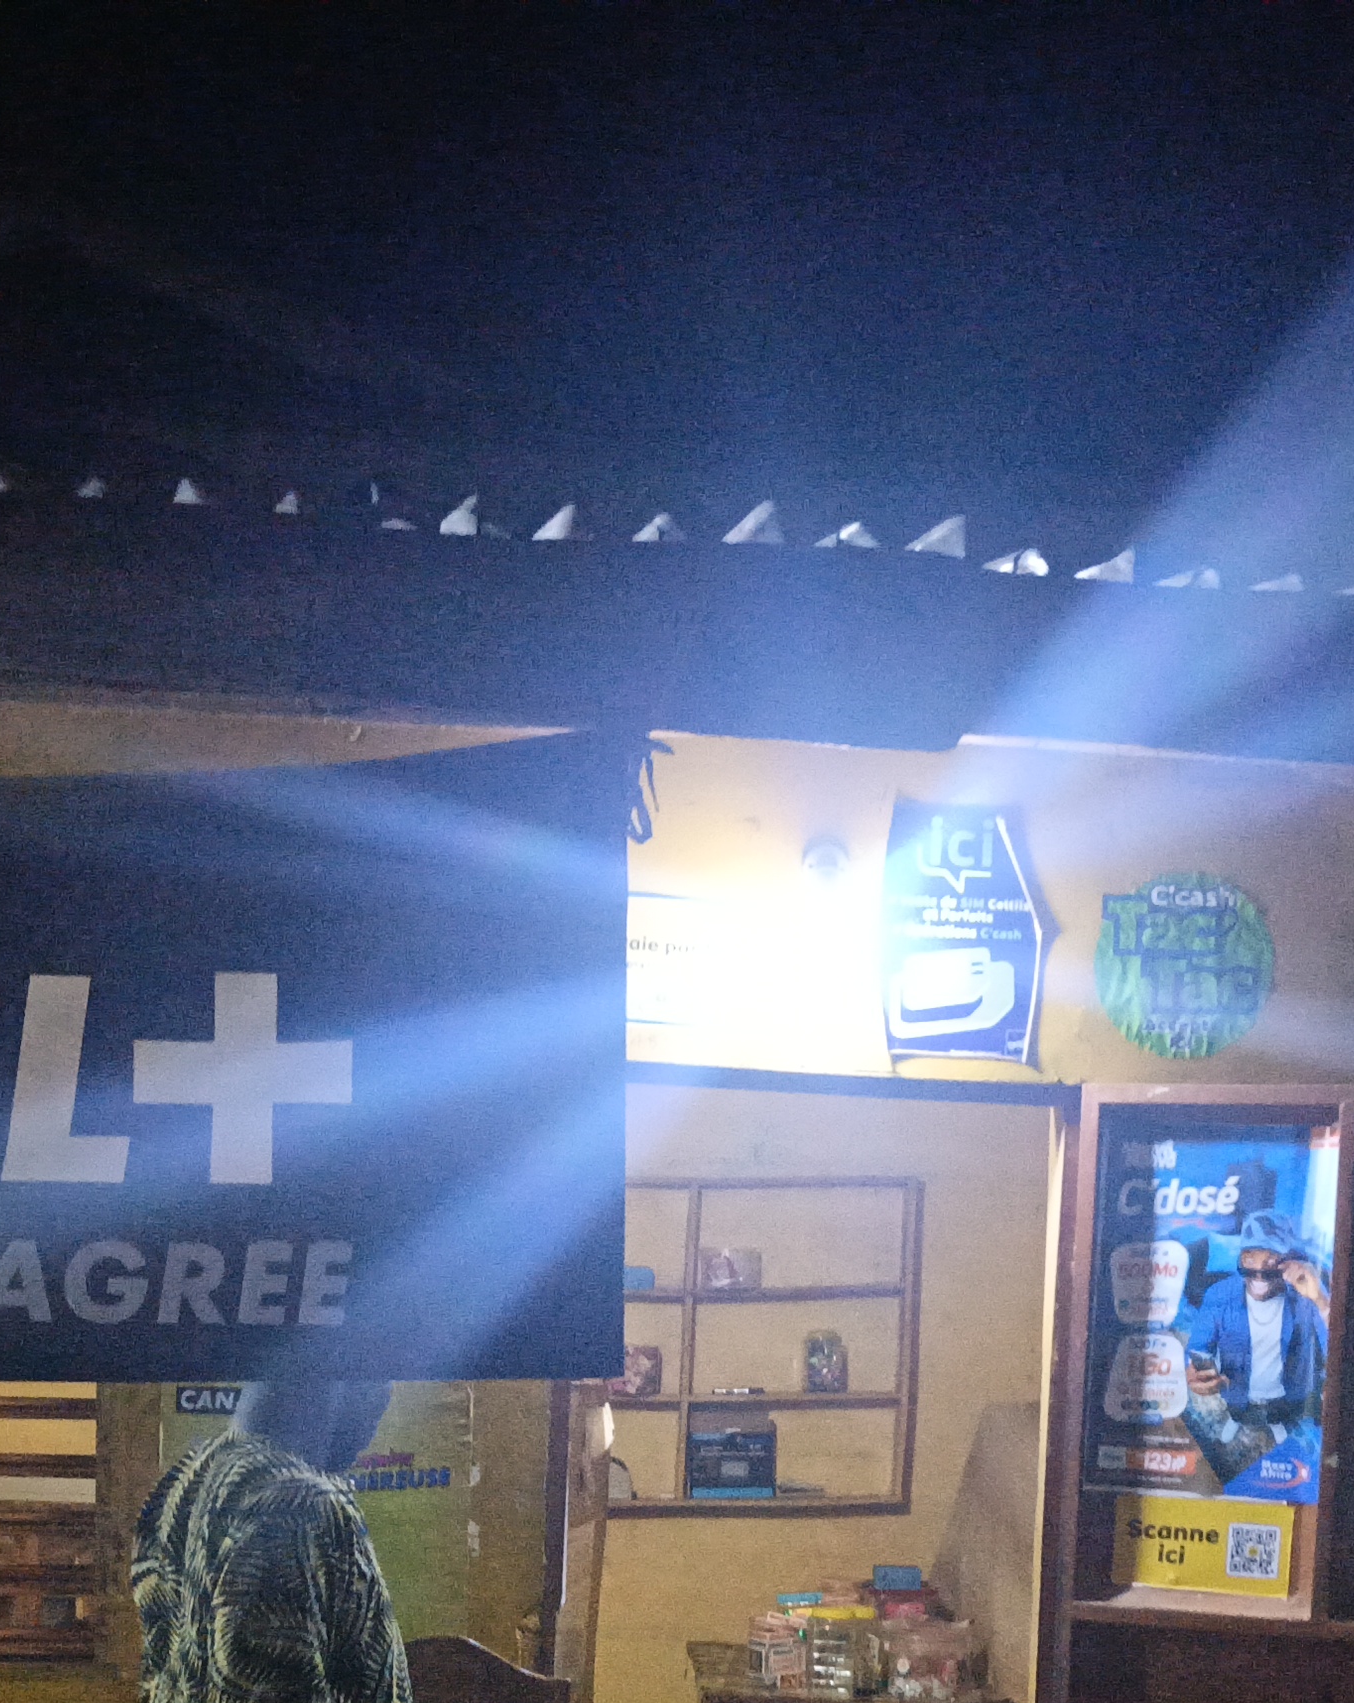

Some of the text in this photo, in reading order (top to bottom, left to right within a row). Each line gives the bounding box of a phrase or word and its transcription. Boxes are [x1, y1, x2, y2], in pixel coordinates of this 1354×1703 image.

[930, 815, 995, 868] ici
[1150, 885, 1238, 907] C'cash
[1117, 1175, 1242, 1216] C'dosé
[180, 1389, 236, 1410] CAN
[1127, 1519, 1220, 1544] Scanne
[1158, 1544, 1186, 1565] ici
